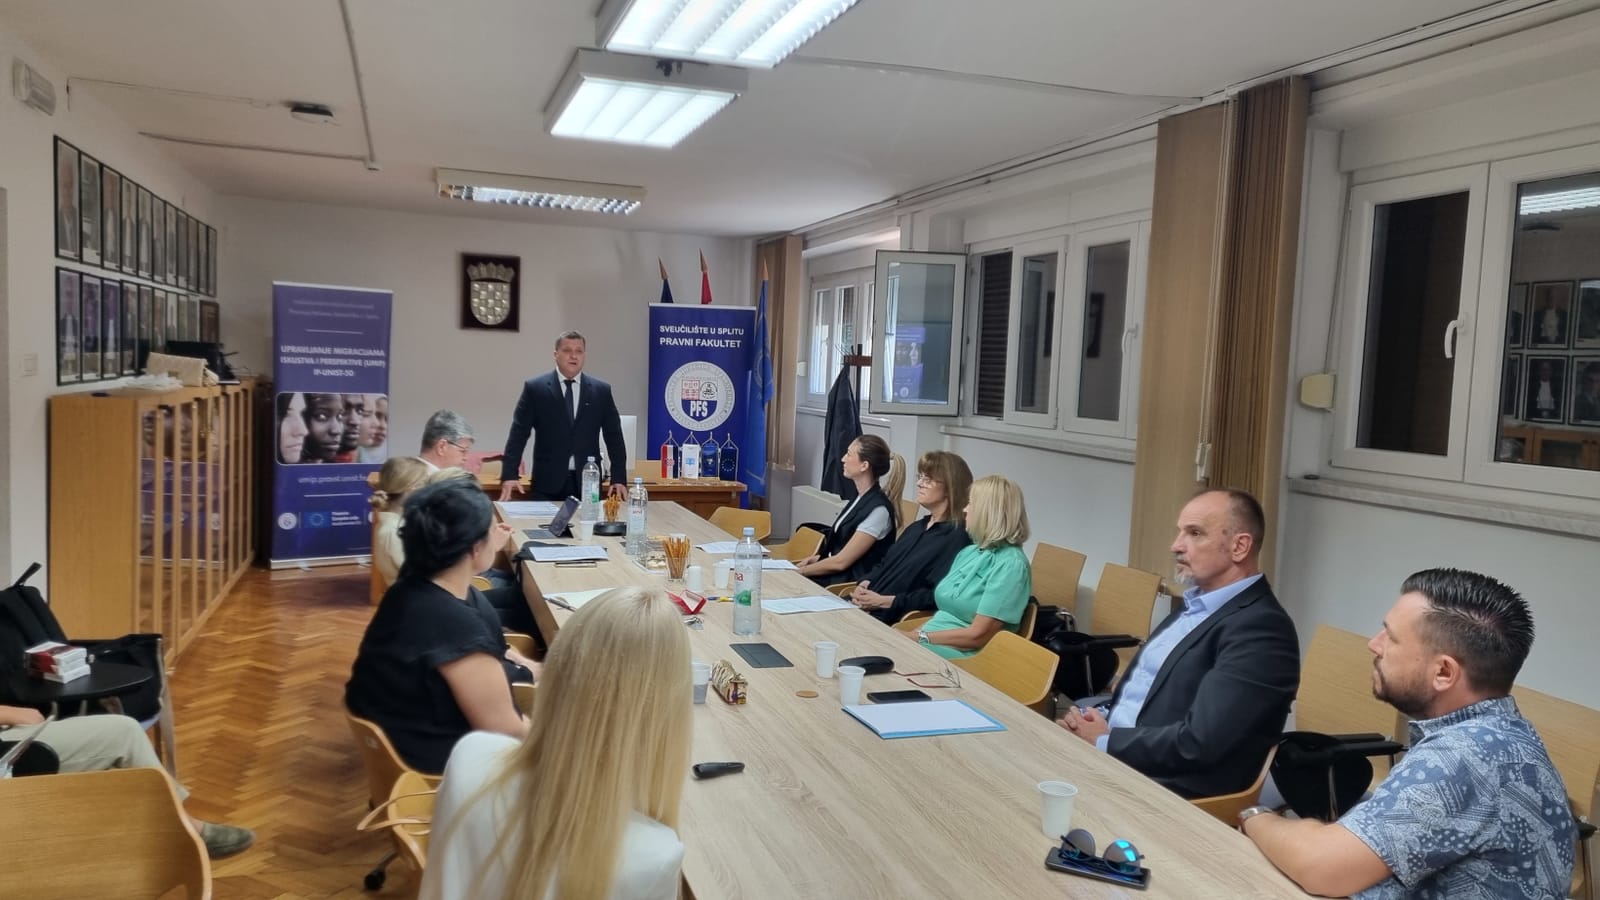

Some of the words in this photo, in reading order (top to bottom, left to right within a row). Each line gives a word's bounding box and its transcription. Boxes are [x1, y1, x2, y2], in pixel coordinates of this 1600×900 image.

[659, 324, 708, 334] SVEUČILIŠTE
[659, 337, 693, 346] PRAVNI
[695, 338, 742, 348] FAKULTET
[690, 400, 708, 417] PFS
